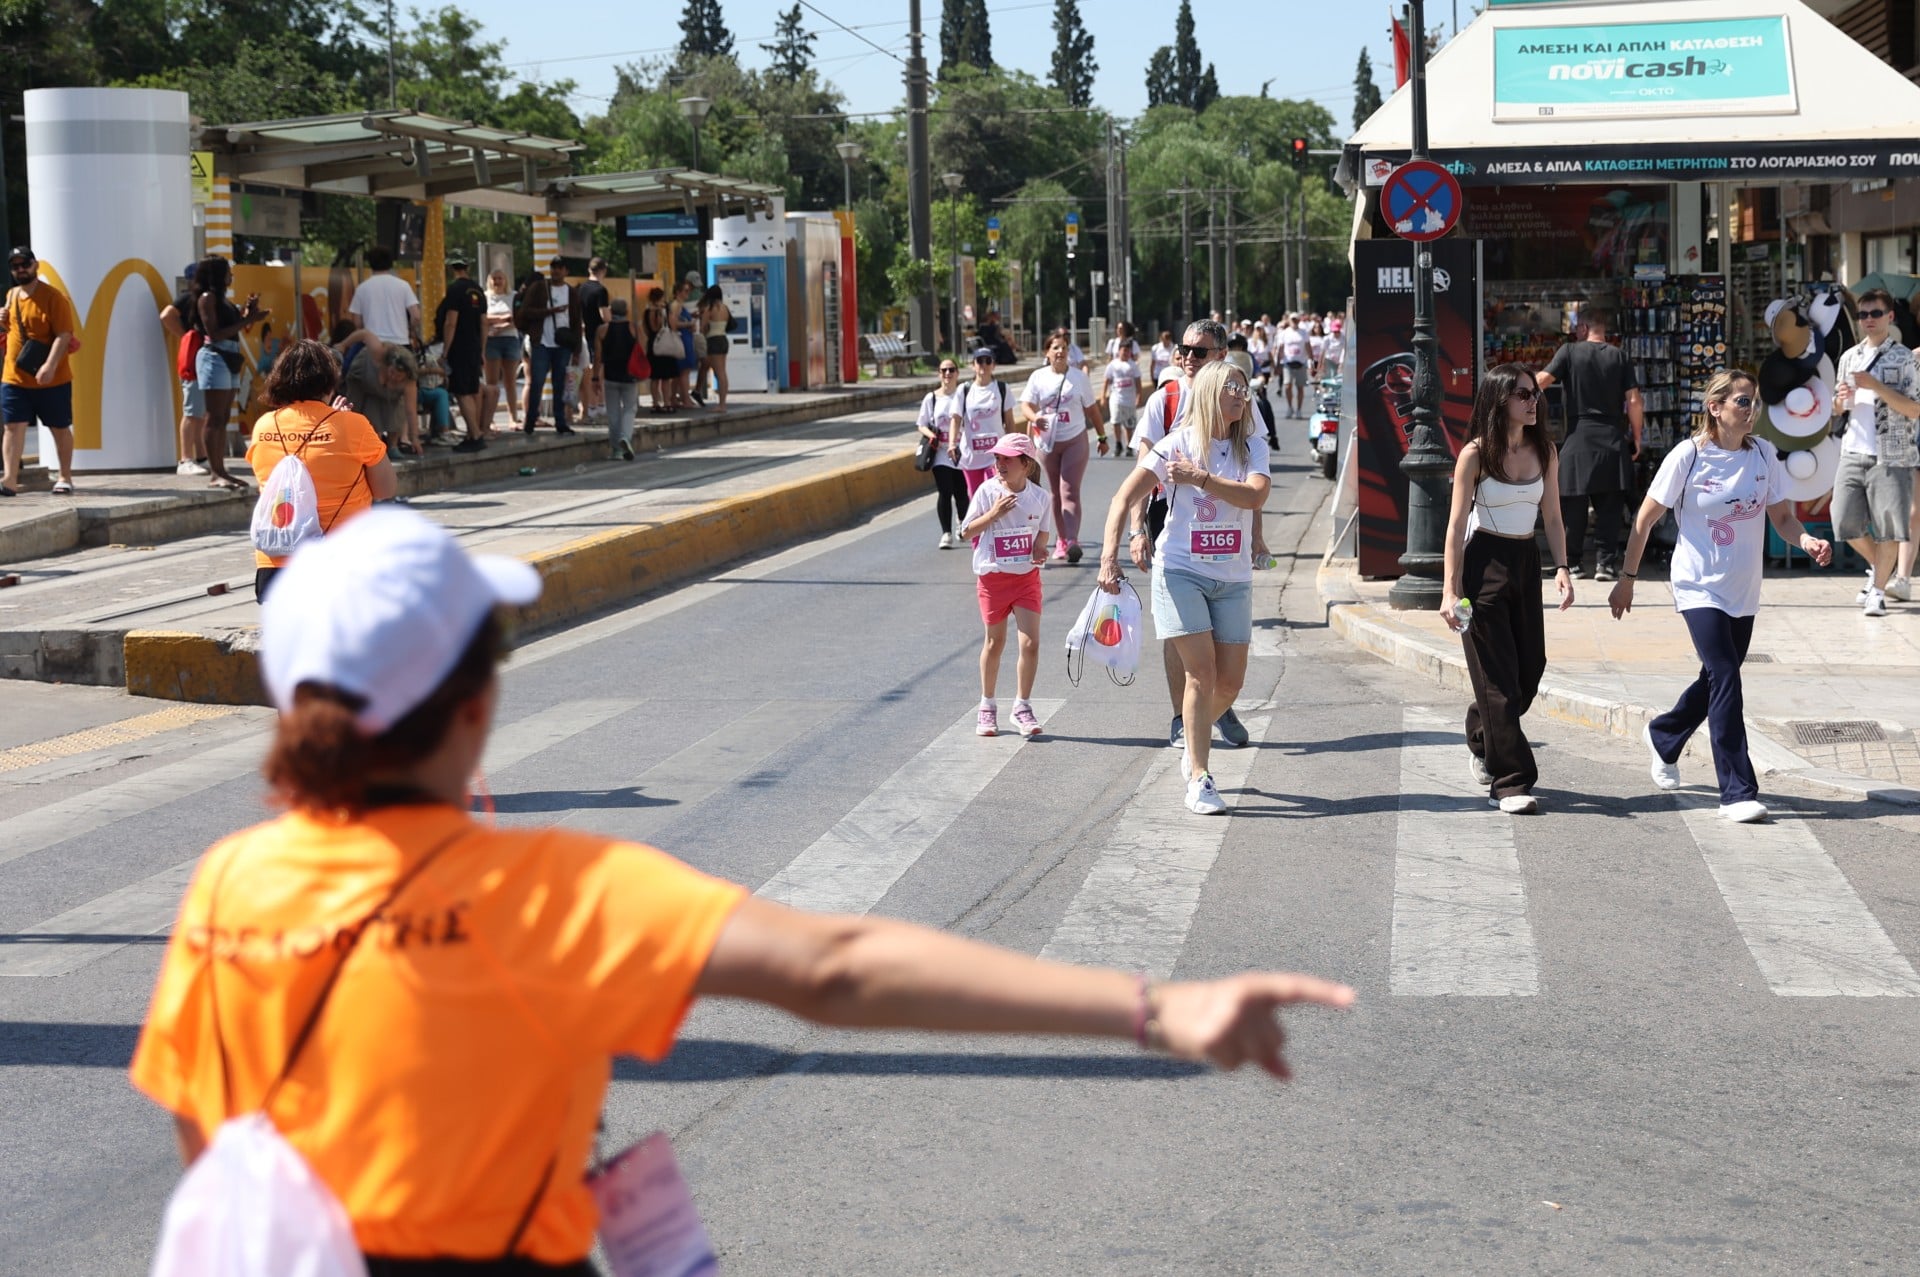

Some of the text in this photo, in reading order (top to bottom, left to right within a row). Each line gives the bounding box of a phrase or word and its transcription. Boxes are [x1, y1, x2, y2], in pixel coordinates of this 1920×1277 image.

[1518, 36, 1763, 54] ΑΜΕΣΗ ΚΑΙ ΑΠΛΗ ΚΑΤΑΘΕΣΗ
[1486, 155, 1877, 174] ΑΜΕΣΑ & ΑΠΛΑ ΚΑΤΑΘΕΣΗ ΜΕΤΡΗΤΩΝ ΣΤΟ ΛΟΓΑΡΙΑΣΜΟ ΣΟΥ
[1378, 267, 1413, 288] HEL
[258, 432, 332, 442] ΕΘΕΛΟΝΤΗΣ
[1002, 537, 1029, 551] 3411
[1200, 533, 1235, 547] 3166
